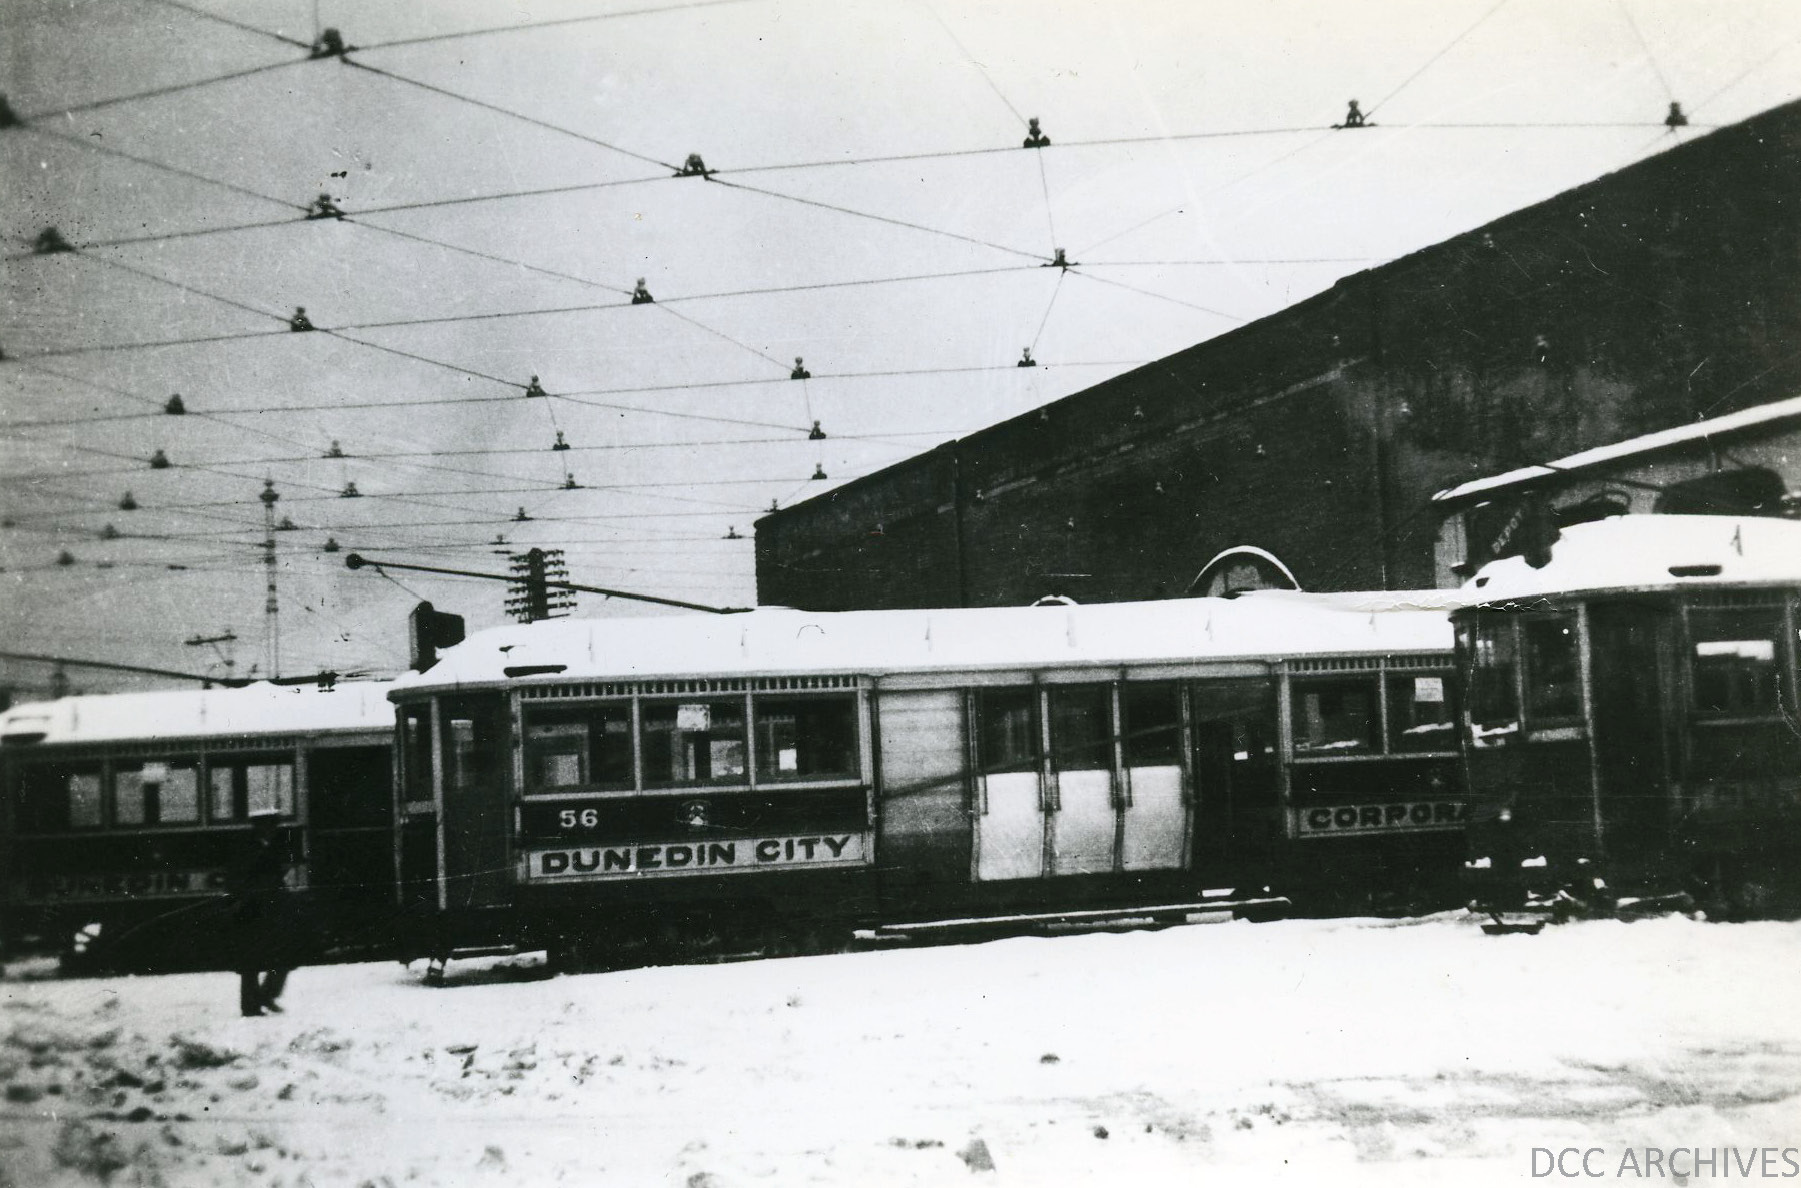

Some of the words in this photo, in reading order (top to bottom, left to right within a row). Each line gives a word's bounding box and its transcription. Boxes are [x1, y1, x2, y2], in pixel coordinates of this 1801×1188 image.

[559, 809, 599, 828] 56
[541, 842, 736, 875] DUNEDIN
[755, 835, 851, 862] CITY
